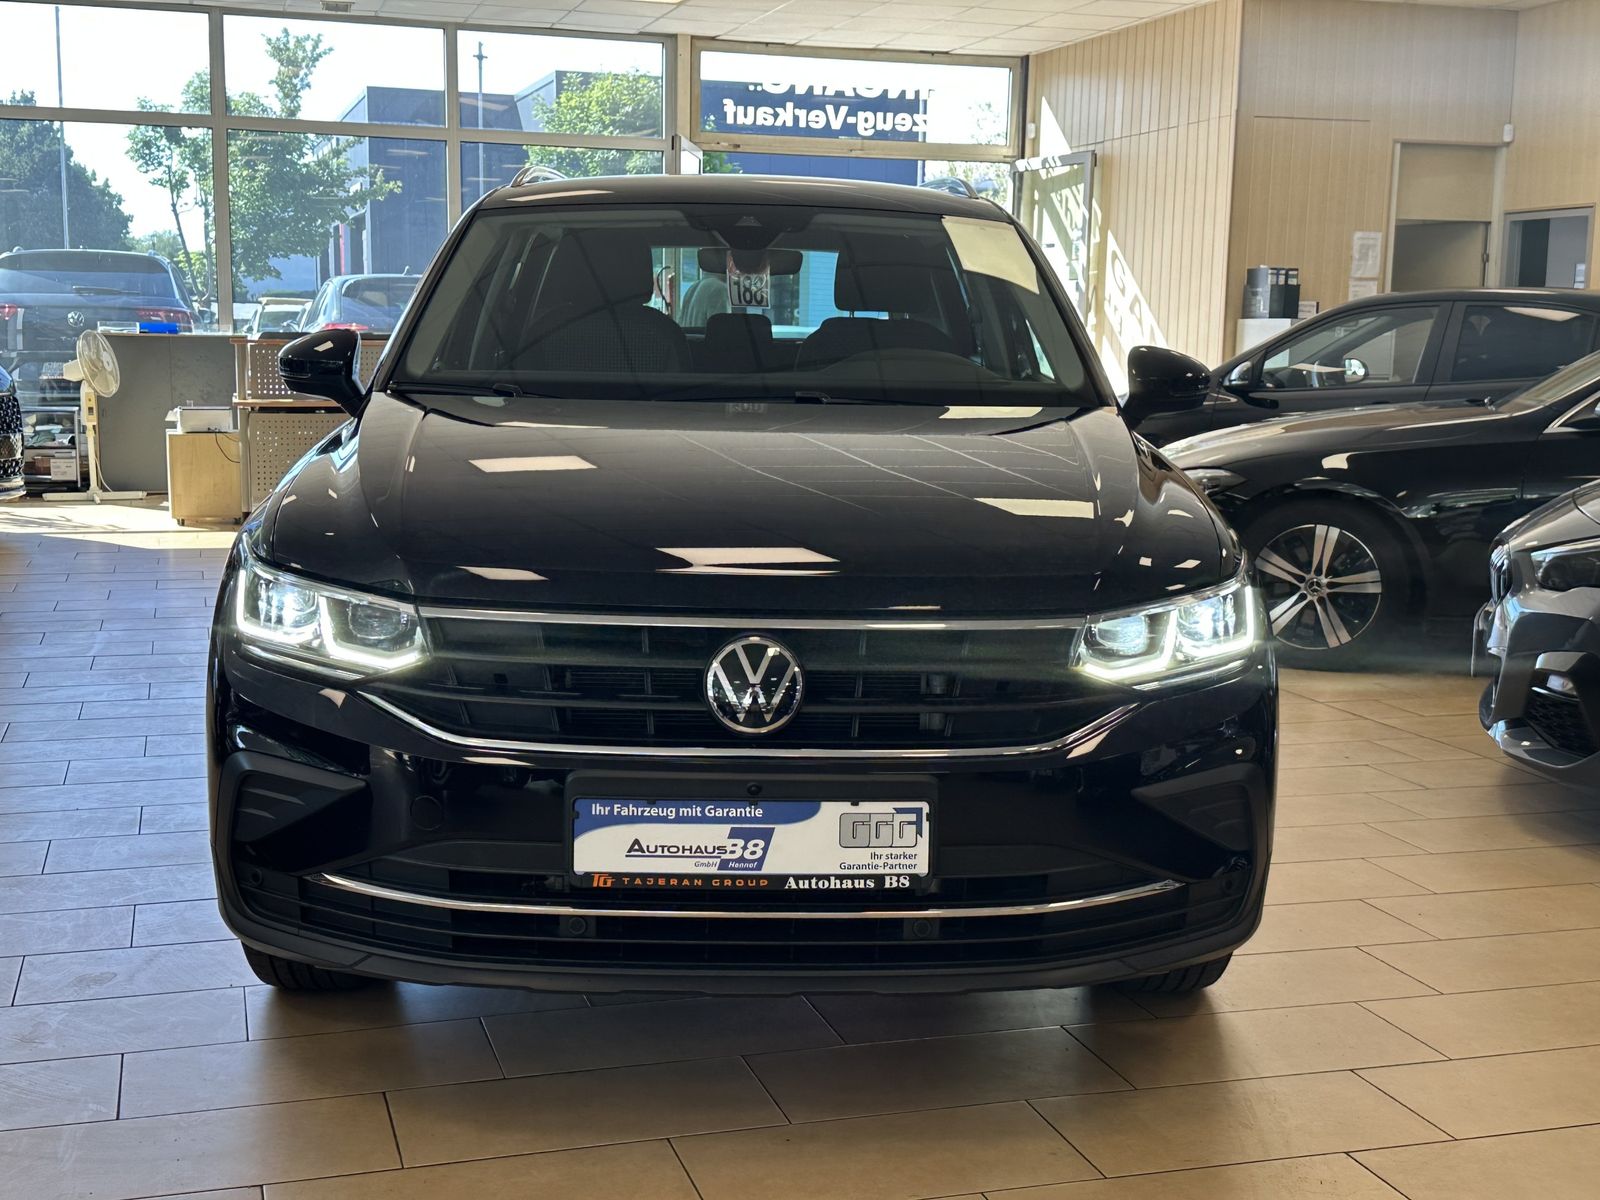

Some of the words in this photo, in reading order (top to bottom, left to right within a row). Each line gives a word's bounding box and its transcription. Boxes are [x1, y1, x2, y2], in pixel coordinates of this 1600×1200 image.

[592, 803, 611, 816] Ihr
[613, 803, 676, 819] Fahrzeug
[679, 805, 702, 817] mit
[704, 805, 763, 818] Garantie
[870, 852, 883, 861] Ihr
[885, 852, 918, 861] starker
[839, 861, 918, 871] Garantie-Partner
[622, 877, 702, 887] TAJERAN
[711, 879, 769, 888] GROUP
[784, 876, 875, 889] Autohaus
[883, 875, 910, 889] B8
